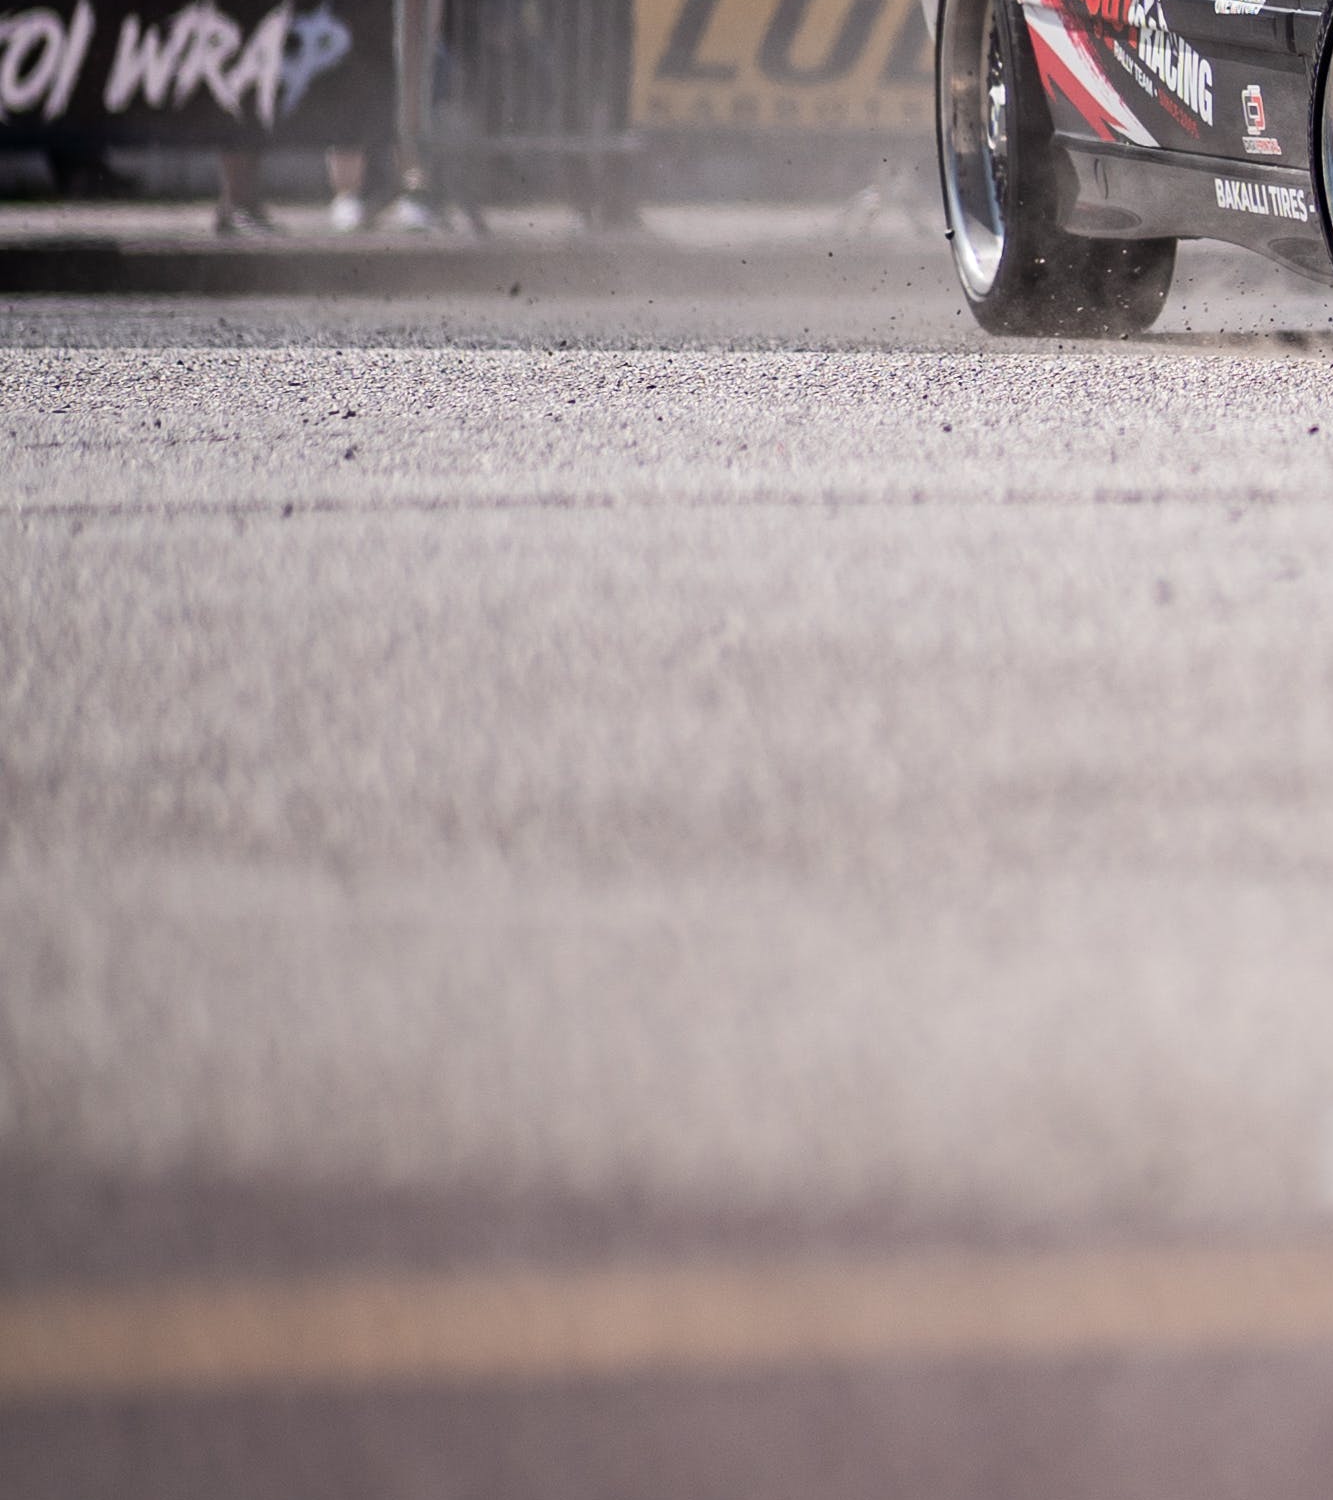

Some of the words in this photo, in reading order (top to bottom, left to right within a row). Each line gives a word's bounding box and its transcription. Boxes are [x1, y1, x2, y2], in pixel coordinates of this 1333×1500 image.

[1137, 17, 1214, 128] RACING
[1214, 177, 1270, 216] BAKALLI
[1268, 185, 1308, 223] TIRES
